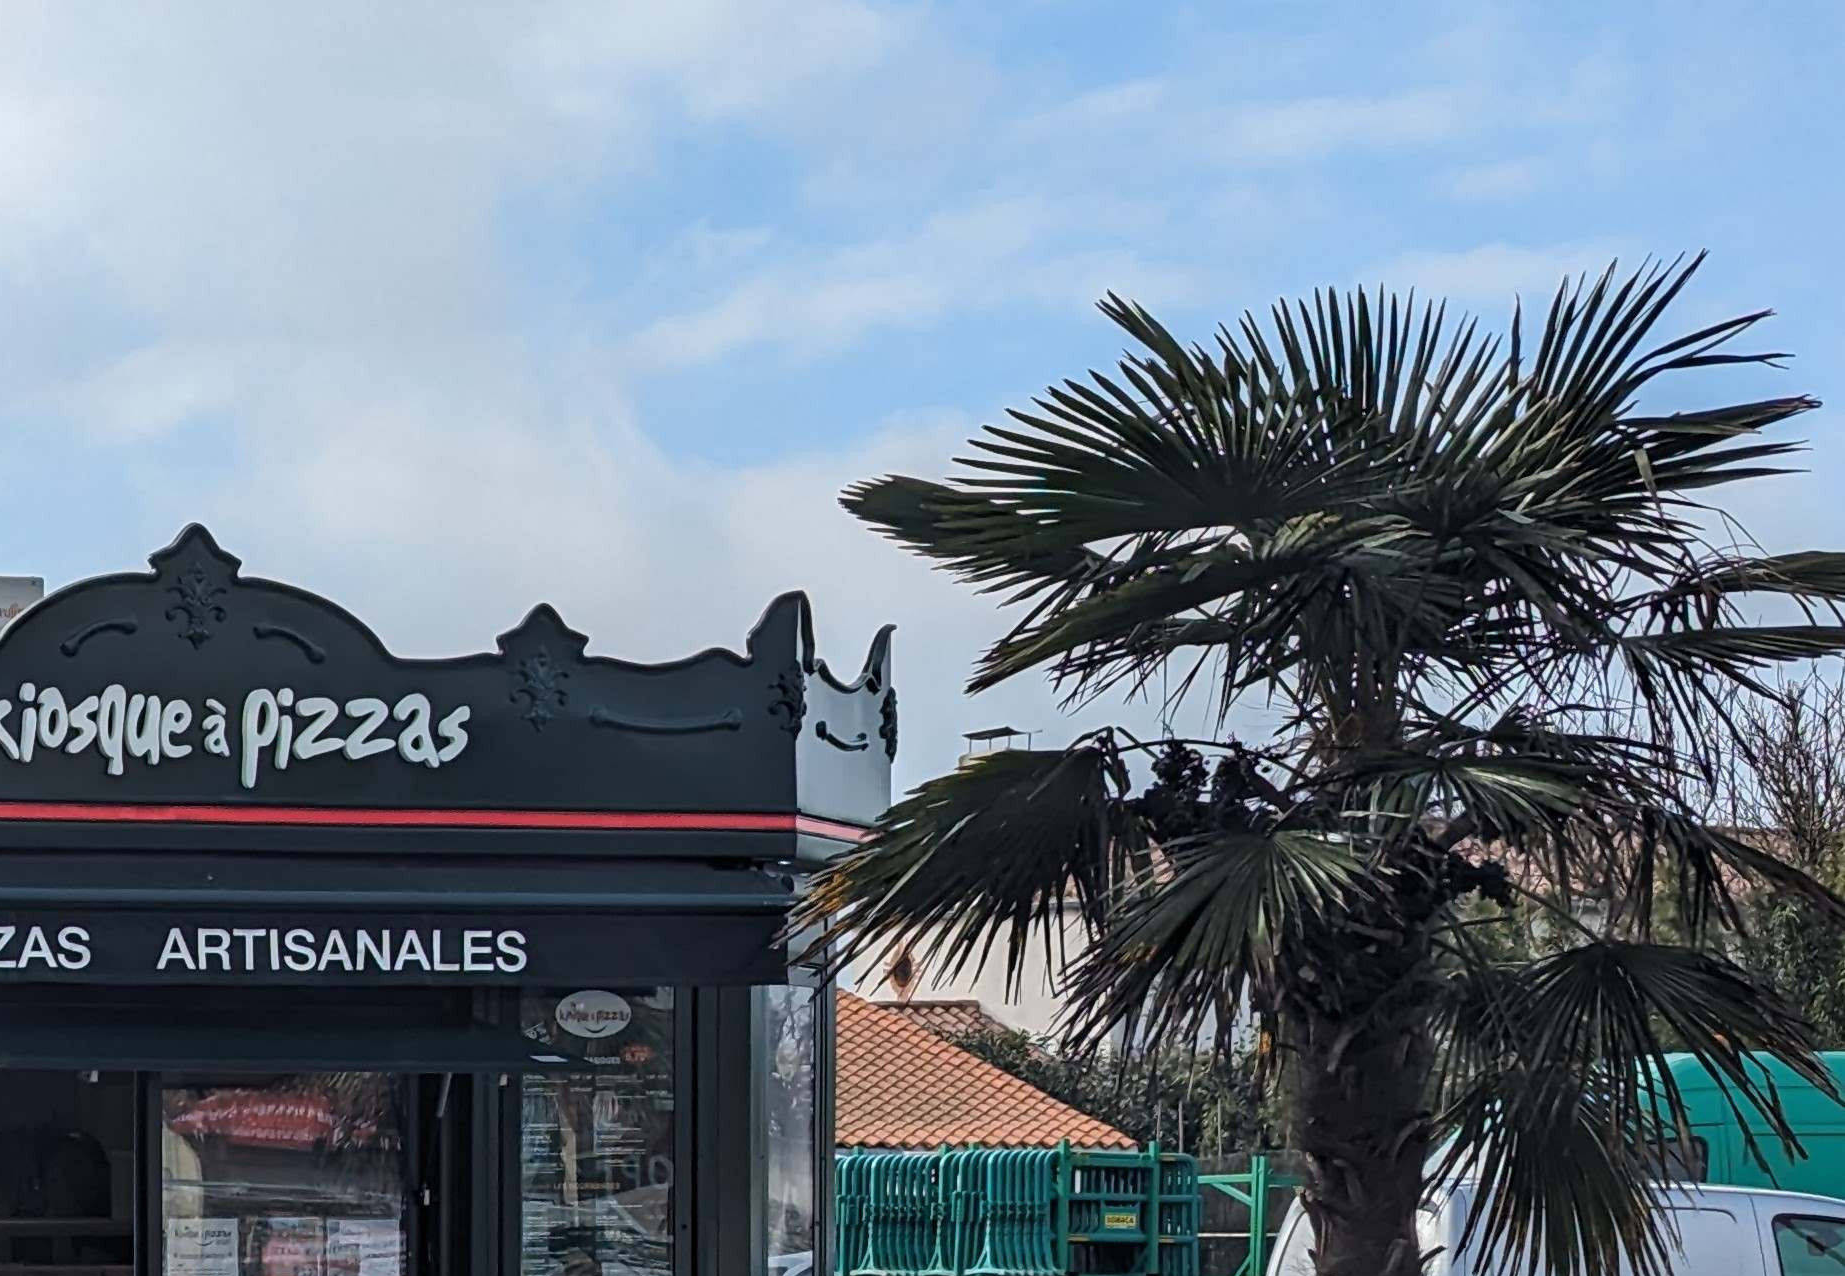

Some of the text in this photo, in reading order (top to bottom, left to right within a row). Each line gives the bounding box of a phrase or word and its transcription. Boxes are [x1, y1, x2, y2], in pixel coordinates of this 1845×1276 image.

[201, 699, 231, 757] à
[241, 686, 471, 789] pizzas
[155, 927, 528, 973] ARTISANALES
